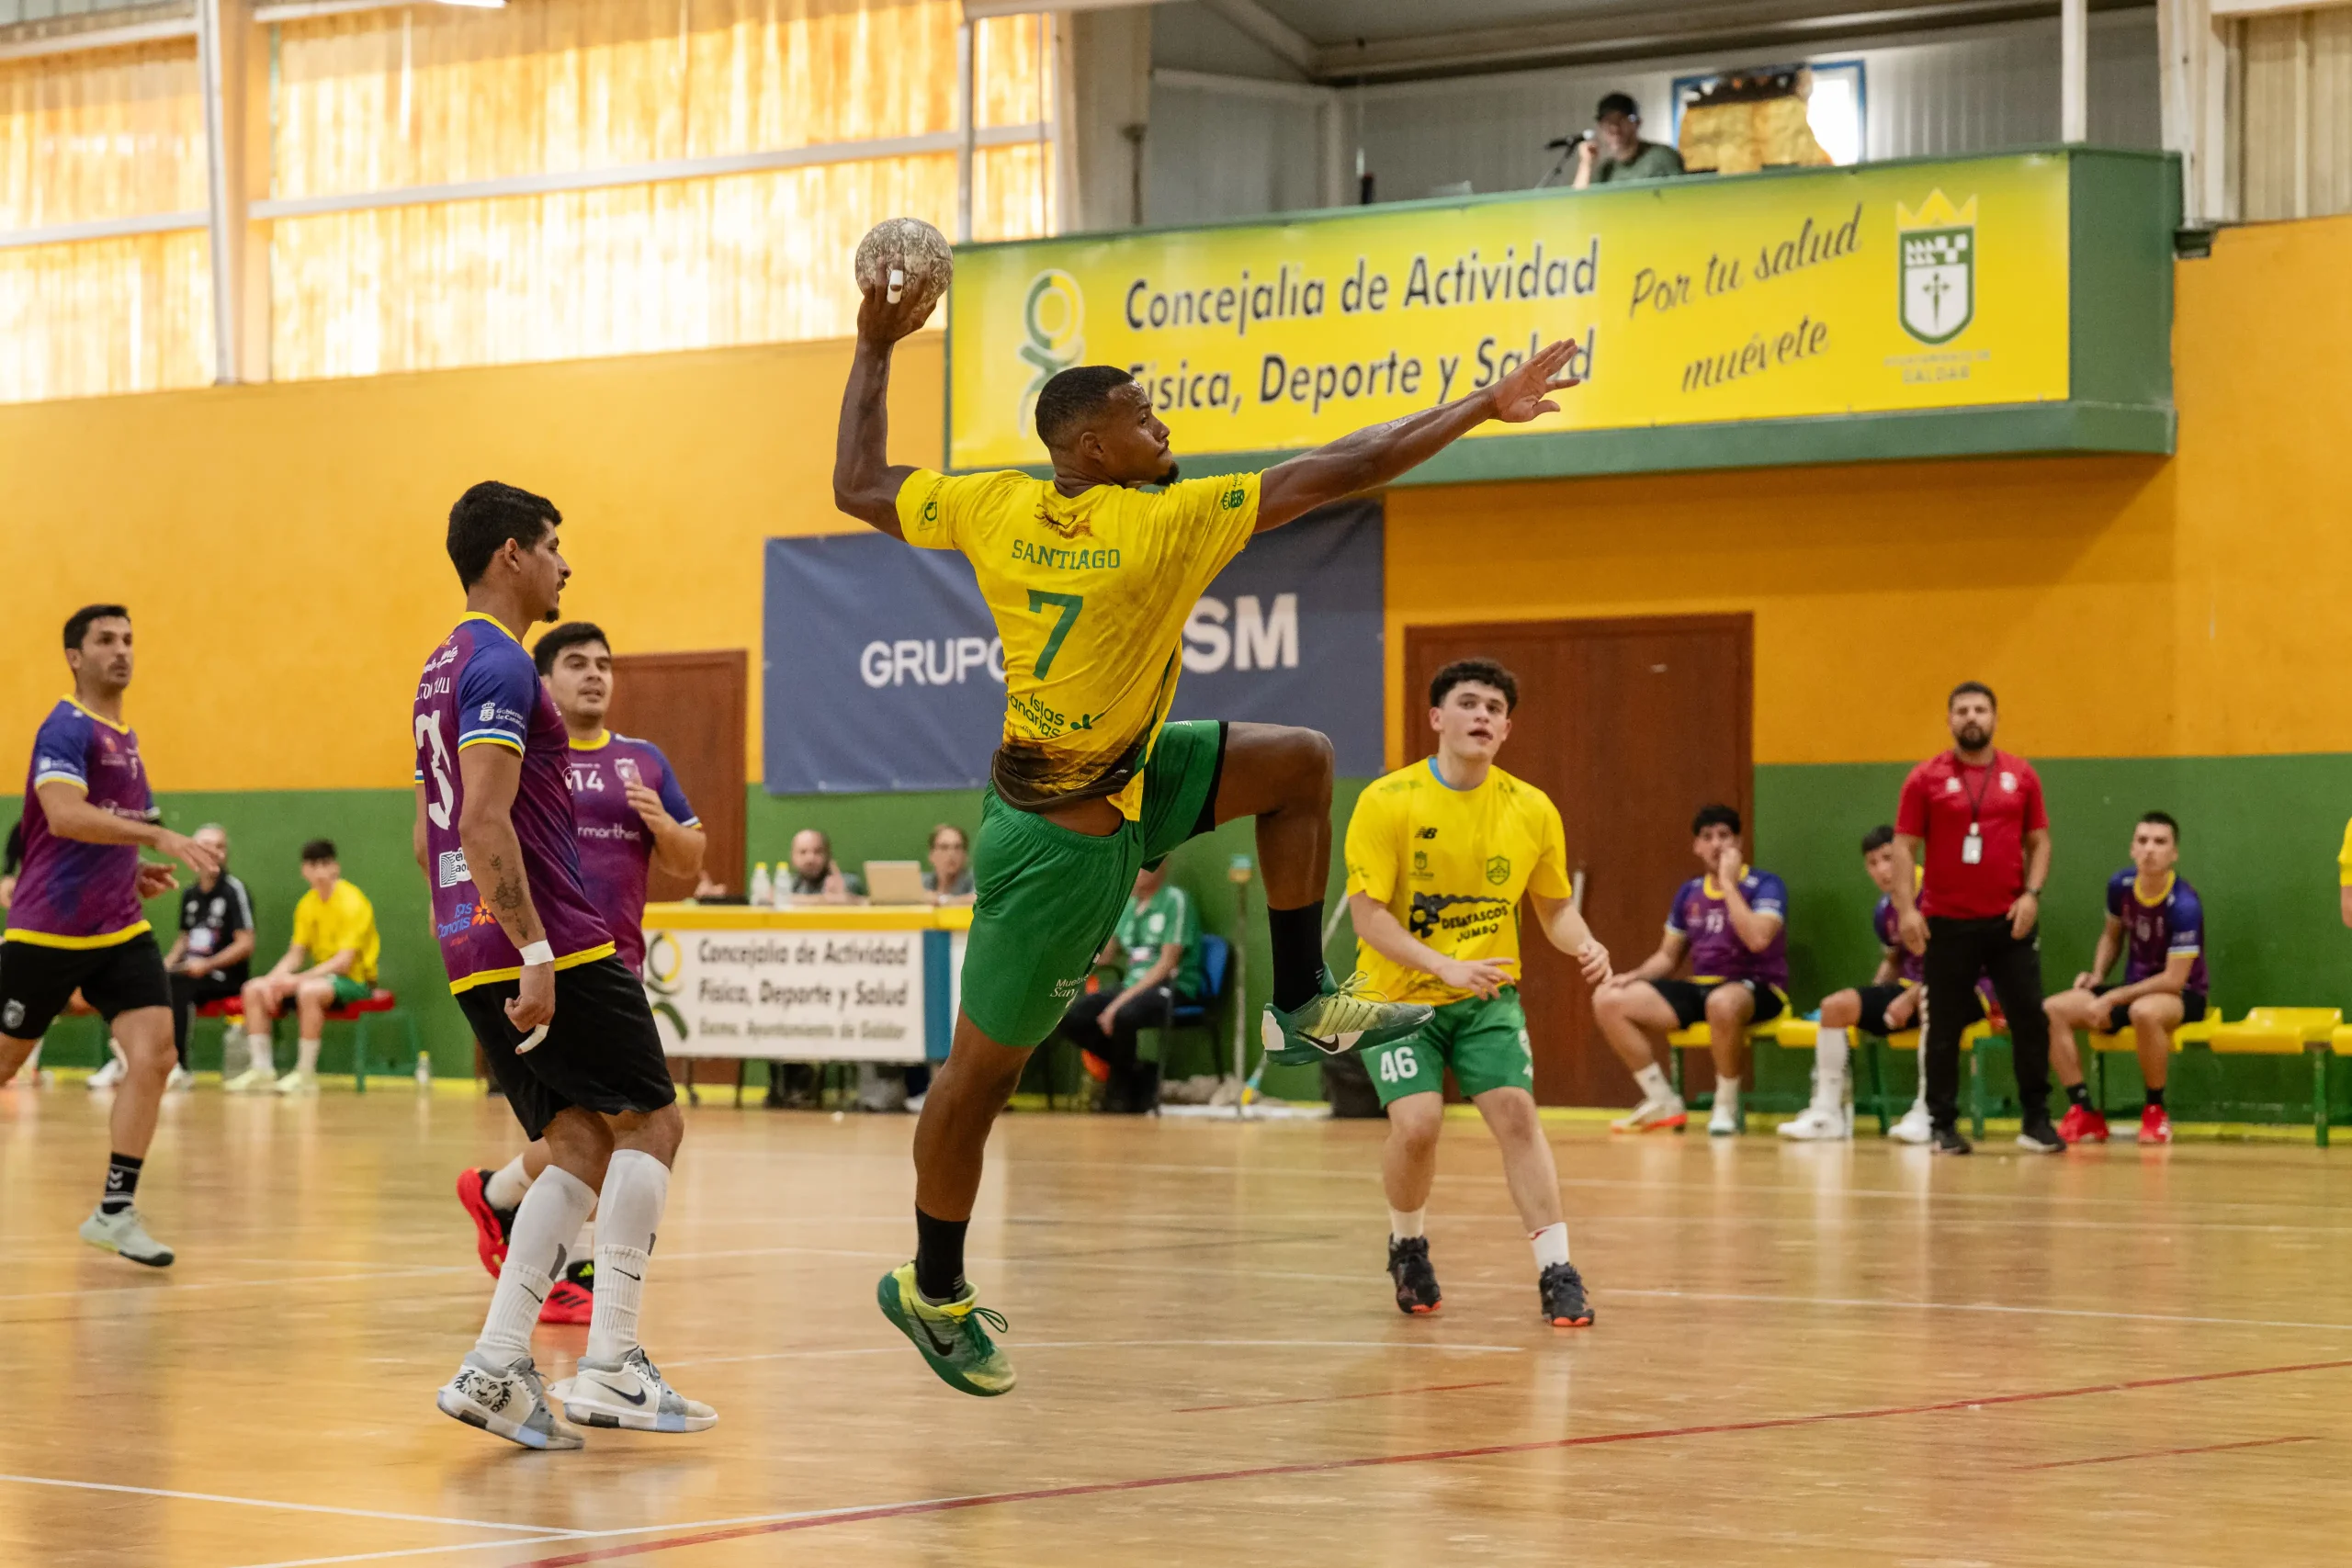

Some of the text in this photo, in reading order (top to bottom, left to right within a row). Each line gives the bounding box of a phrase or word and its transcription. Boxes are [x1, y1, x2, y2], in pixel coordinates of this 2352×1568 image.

[1341, 254, 1389, 313] de
[1403, 235, 1599, 309] Actividad
[1629, 199, 1863, 320] Por tu salud
[1259, 350, 1422, 415] Deporte
[1438, 356, 1459, 404] y
[1473, 325, 1596, 389] Sald
[1681, 314, 1830, 393] muévete
[1012, 539, 1121, 570] SANTIAGO
[1026, 588, 1084, 681] 7
[1009, 694, 1061, 739] anarias
[1030, 692, 1065, 727] Islas
[571, 769, 605, 793] 14
[1441, 906, 1509, 931] DESATASCOS
[1456, 923, 1499, 943] JUMBO
[796, 939, 817, 964] de
[823, 938, 910, 964] Actividad
[759, 978, 832, 1010] Deporte
[839, 987, 849, 1013] y
[855, 979, 909, 1006] Salud
[1380, 1045, 1419, 1083] 46
